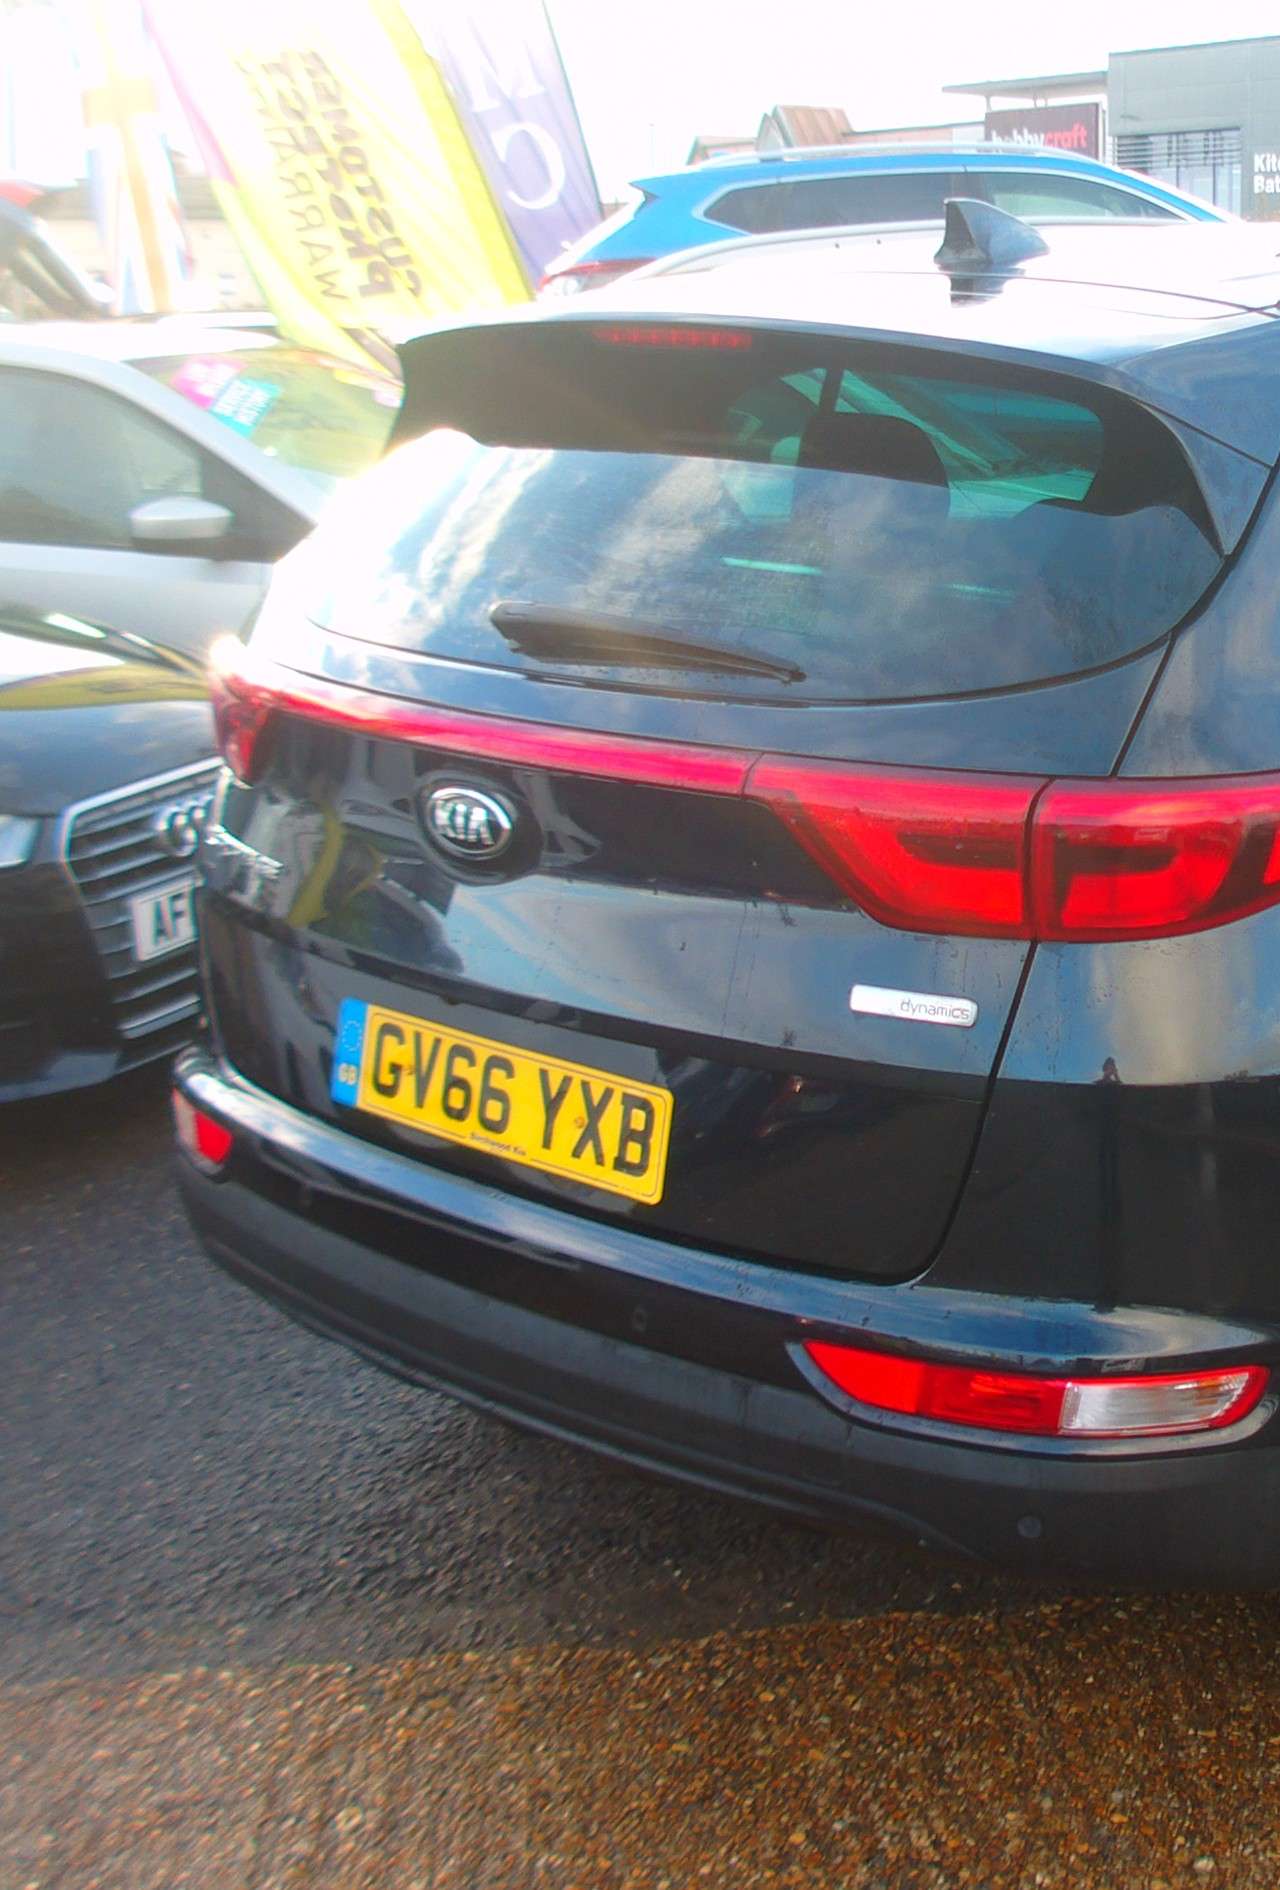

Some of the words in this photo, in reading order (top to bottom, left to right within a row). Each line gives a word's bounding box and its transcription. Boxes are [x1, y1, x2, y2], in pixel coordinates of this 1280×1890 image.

[433, 799, 495, 846] KIA
[900, 998, 970, 1021] dynamics
[372, 1022, 516, 1135] GV66
[538, 1068, 656, 1178] YXB
